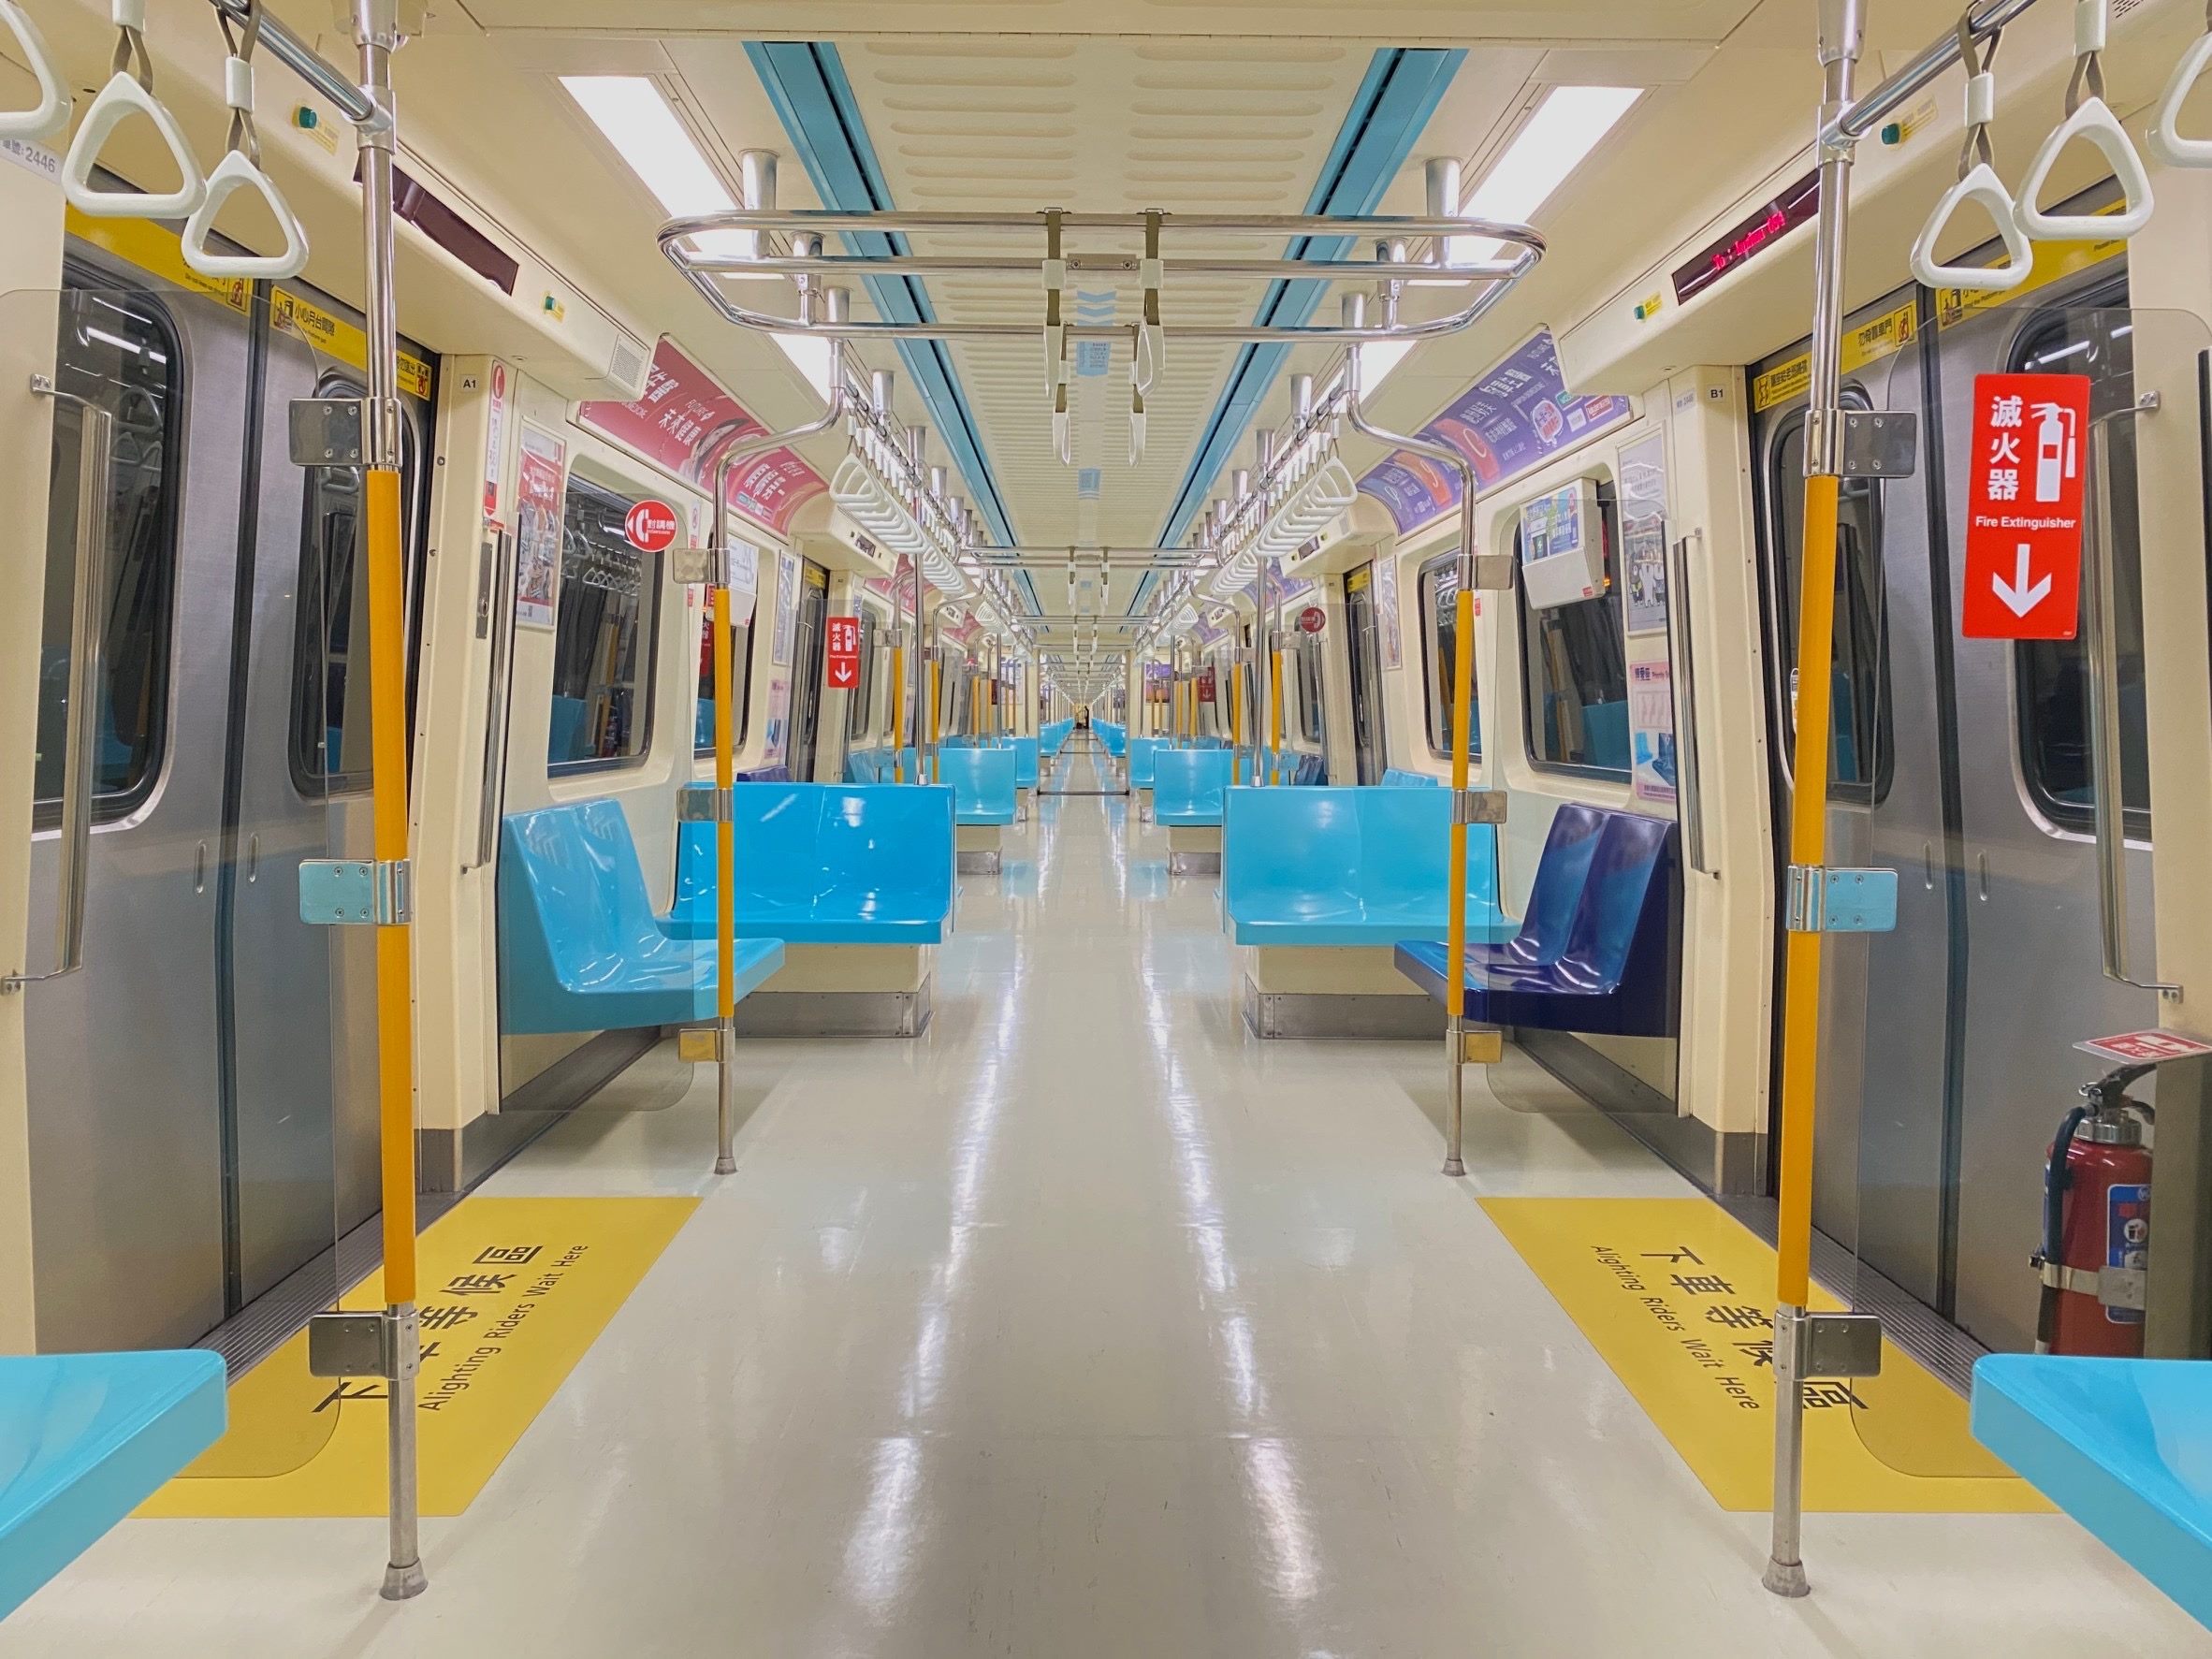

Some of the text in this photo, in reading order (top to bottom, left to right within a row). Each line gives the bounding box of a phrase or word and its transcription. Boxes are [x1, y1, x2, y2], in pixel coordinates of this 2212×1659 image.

[463, 379, 476, 388] A1
[1710, 388, 1724, 399] B1
[1987, 395, 2023, 501] 滅火器
[648, 519, 676, 531] 對講機
[1975, 516, 2076, 531] Fire Extinguisher
[417, 1245, 589, 1411] Alighting Riders Wait Here
[1591, 1245, 1760, 1410] Alighting Riders Wait Here
